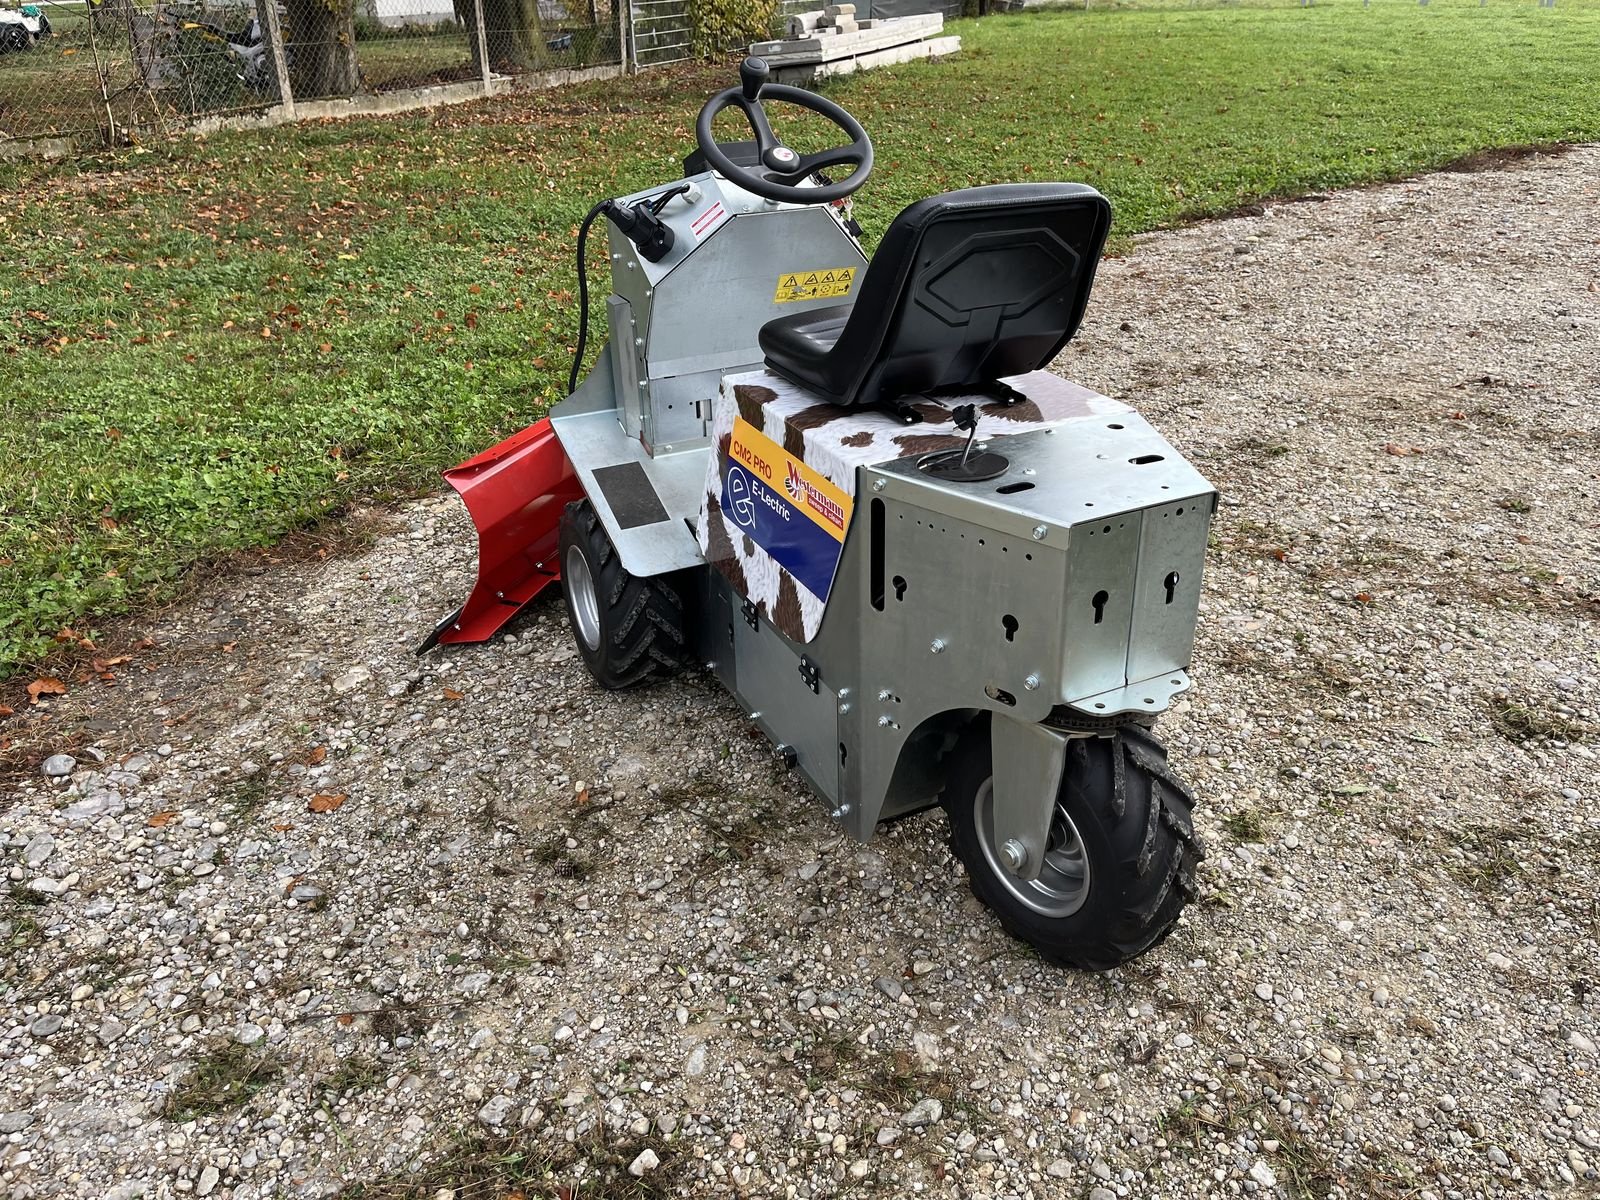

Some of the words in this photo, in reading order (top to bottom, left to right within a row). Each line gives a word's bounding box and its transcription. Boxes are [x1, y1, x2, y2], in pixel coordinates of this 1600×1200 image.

[733, 440, 752, 465] CM2
[753, 455, 772, 480] PRO
[752, 479, 790, 521] E-Lectric
[786, 460, 845, 520] Westermann
